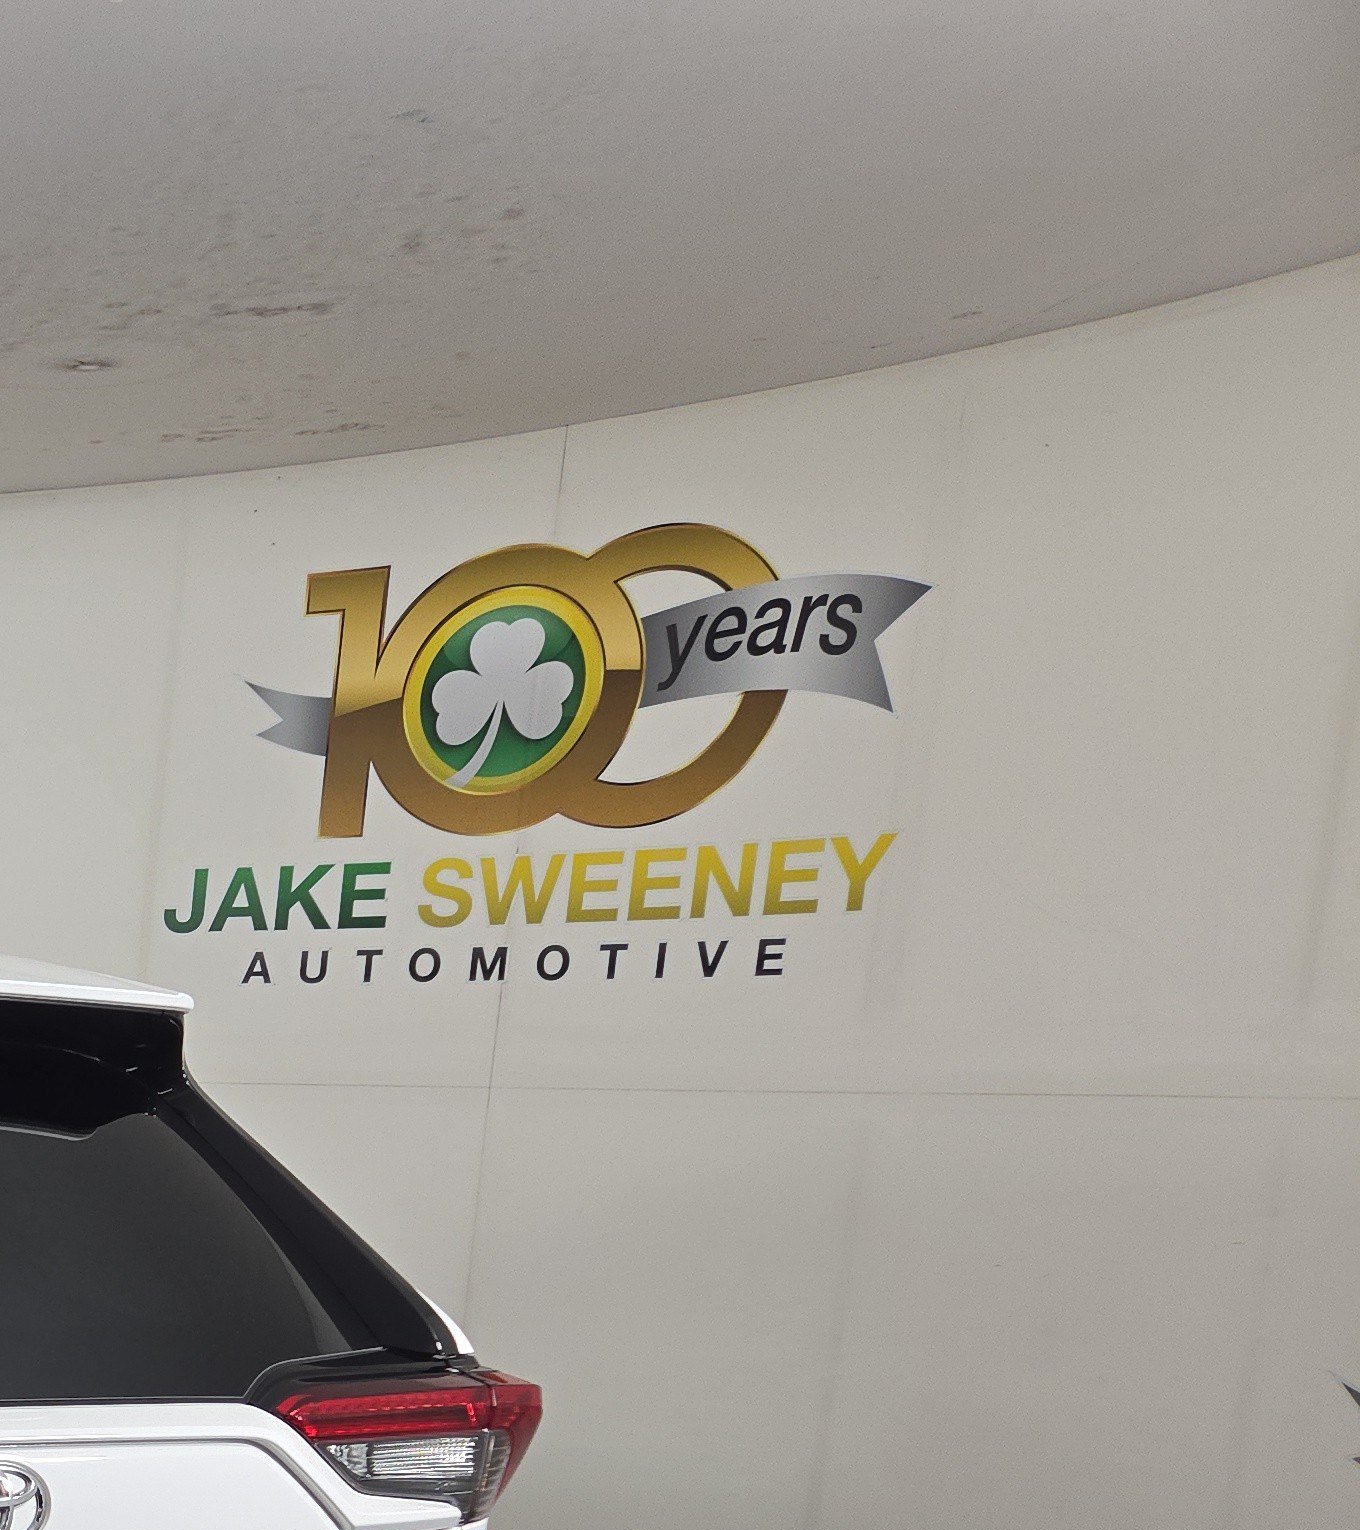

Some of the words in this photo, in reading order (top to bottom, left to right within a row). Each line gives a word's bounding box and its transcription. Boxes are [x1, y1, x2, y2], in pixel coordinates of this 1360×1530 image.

[305, 522, 790, 839] 100
[658, 592, 864, 691] years
[163, 861, 392, 933] JAKE
[417, 833, 898, 928] SWEENEY
[241, 938, 788, 986] AUTOMOTIVE
